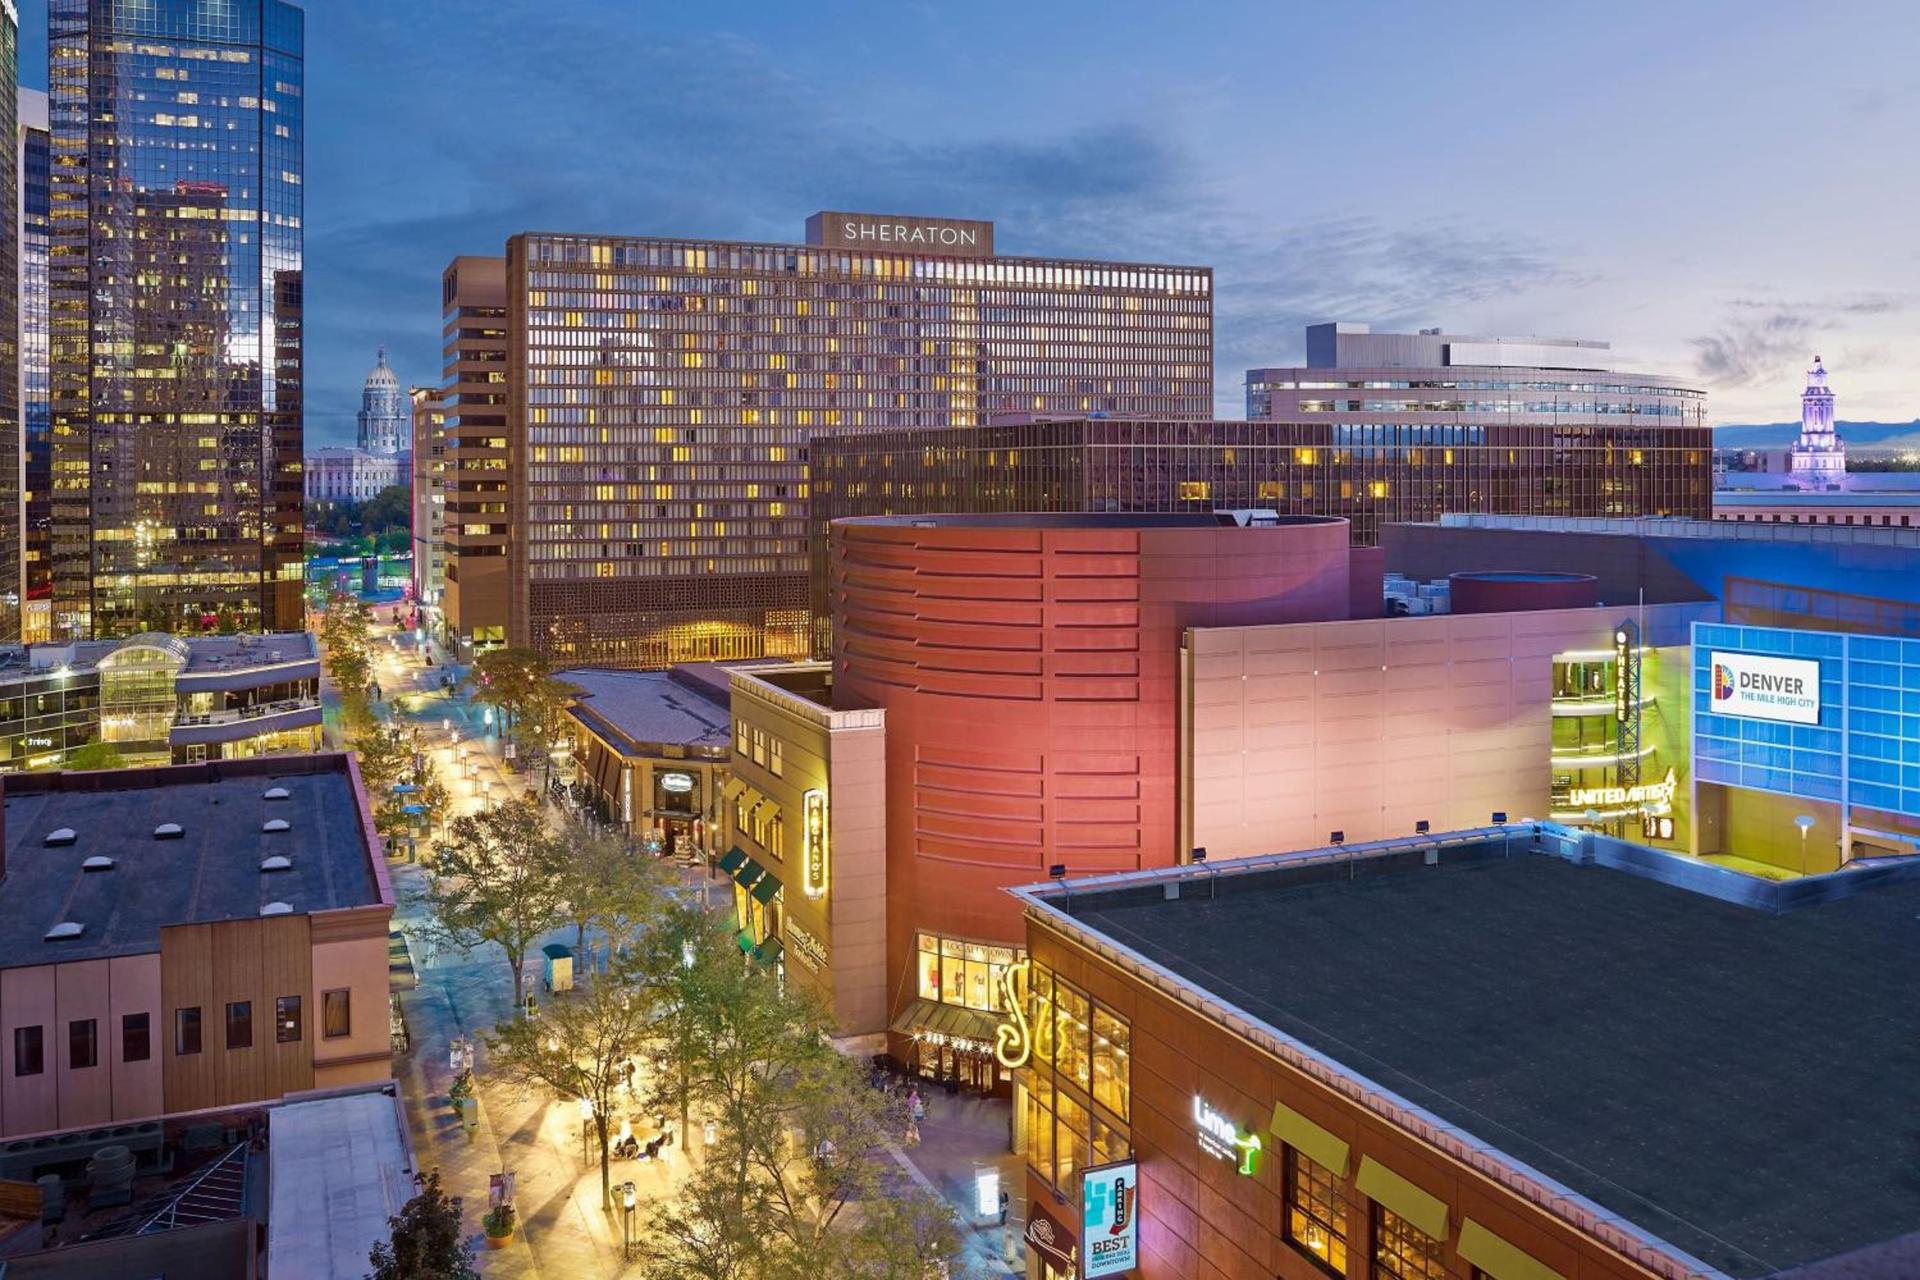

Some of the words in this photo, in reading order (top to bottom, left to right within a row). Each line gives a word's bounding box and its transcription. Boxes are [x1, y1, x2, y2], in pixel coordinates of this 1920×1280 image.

[844, 222, 976, 246] SHERATON
[1616, 644, 1626, 721] THEATRE
[1739, 671, 1804, 695] DENVER
[1741, 691, 1756, 702] THE
[1757, 693, 1776, 704] MILE
[1777, 696, 1797, 706] HIGH
[1797, 698, 1816, 709] CITY
[1569, 787, 1627, 806] UNITED
[1193, 1094, 1236, 1146] Lime
[1116, 1180, 1124, 1223] PARKING
[1091, 1235, 1131, 1255] BEST
